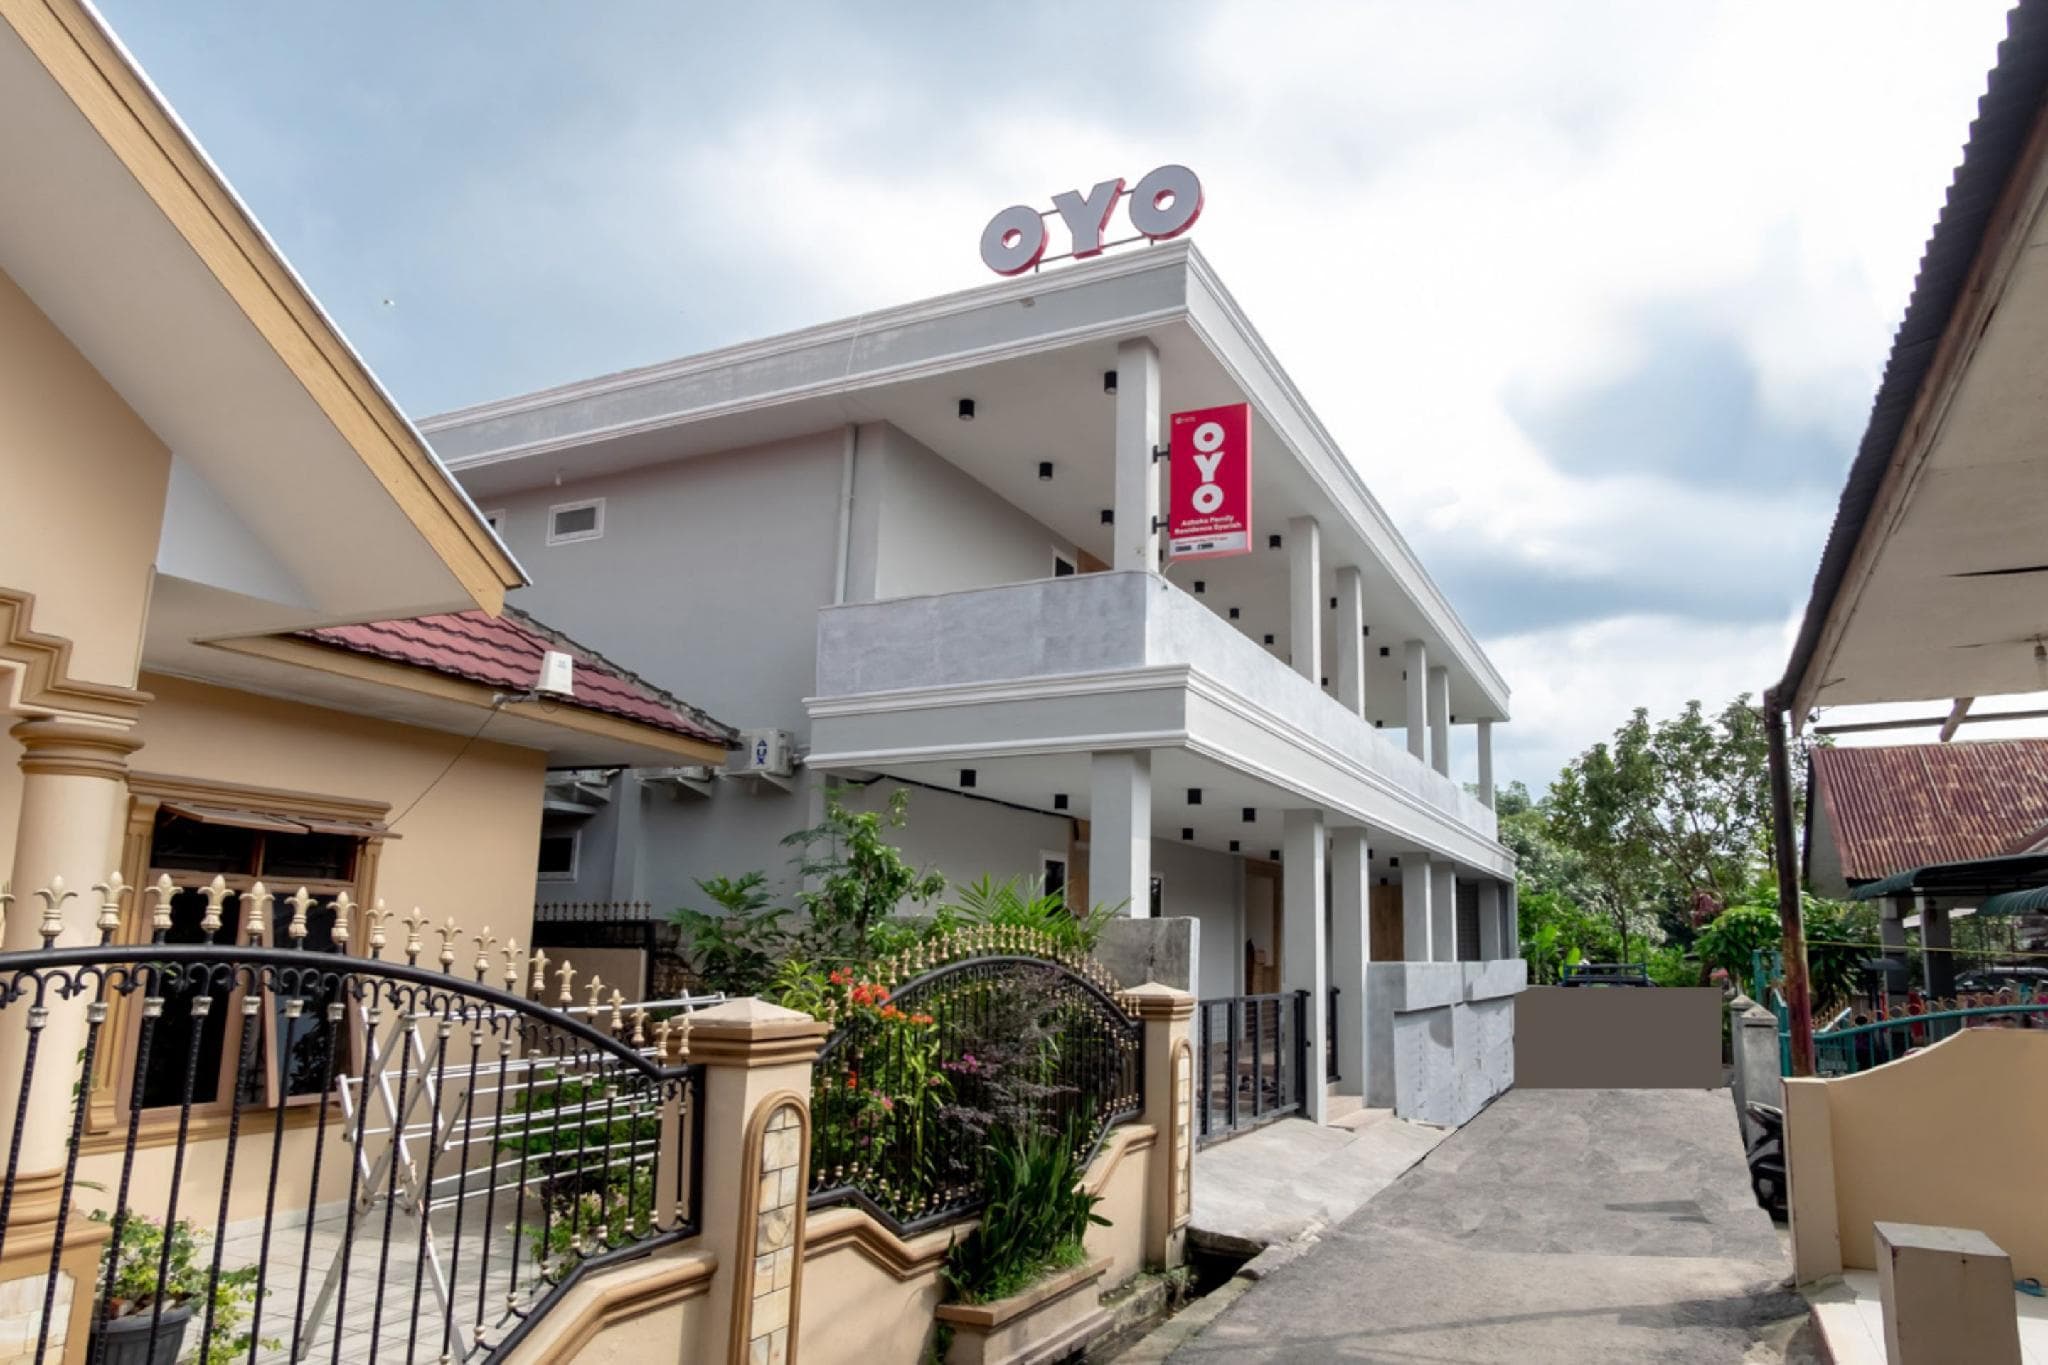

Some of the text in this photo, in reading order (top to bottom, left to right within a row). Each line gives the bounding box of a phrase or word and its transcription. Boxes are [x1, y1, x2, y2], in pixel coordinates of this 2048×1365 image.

[980, 164, 1204, 277] OYO
[1192, 421, 1225, 514] OYO
[756, 738, 768, 765] AUX
